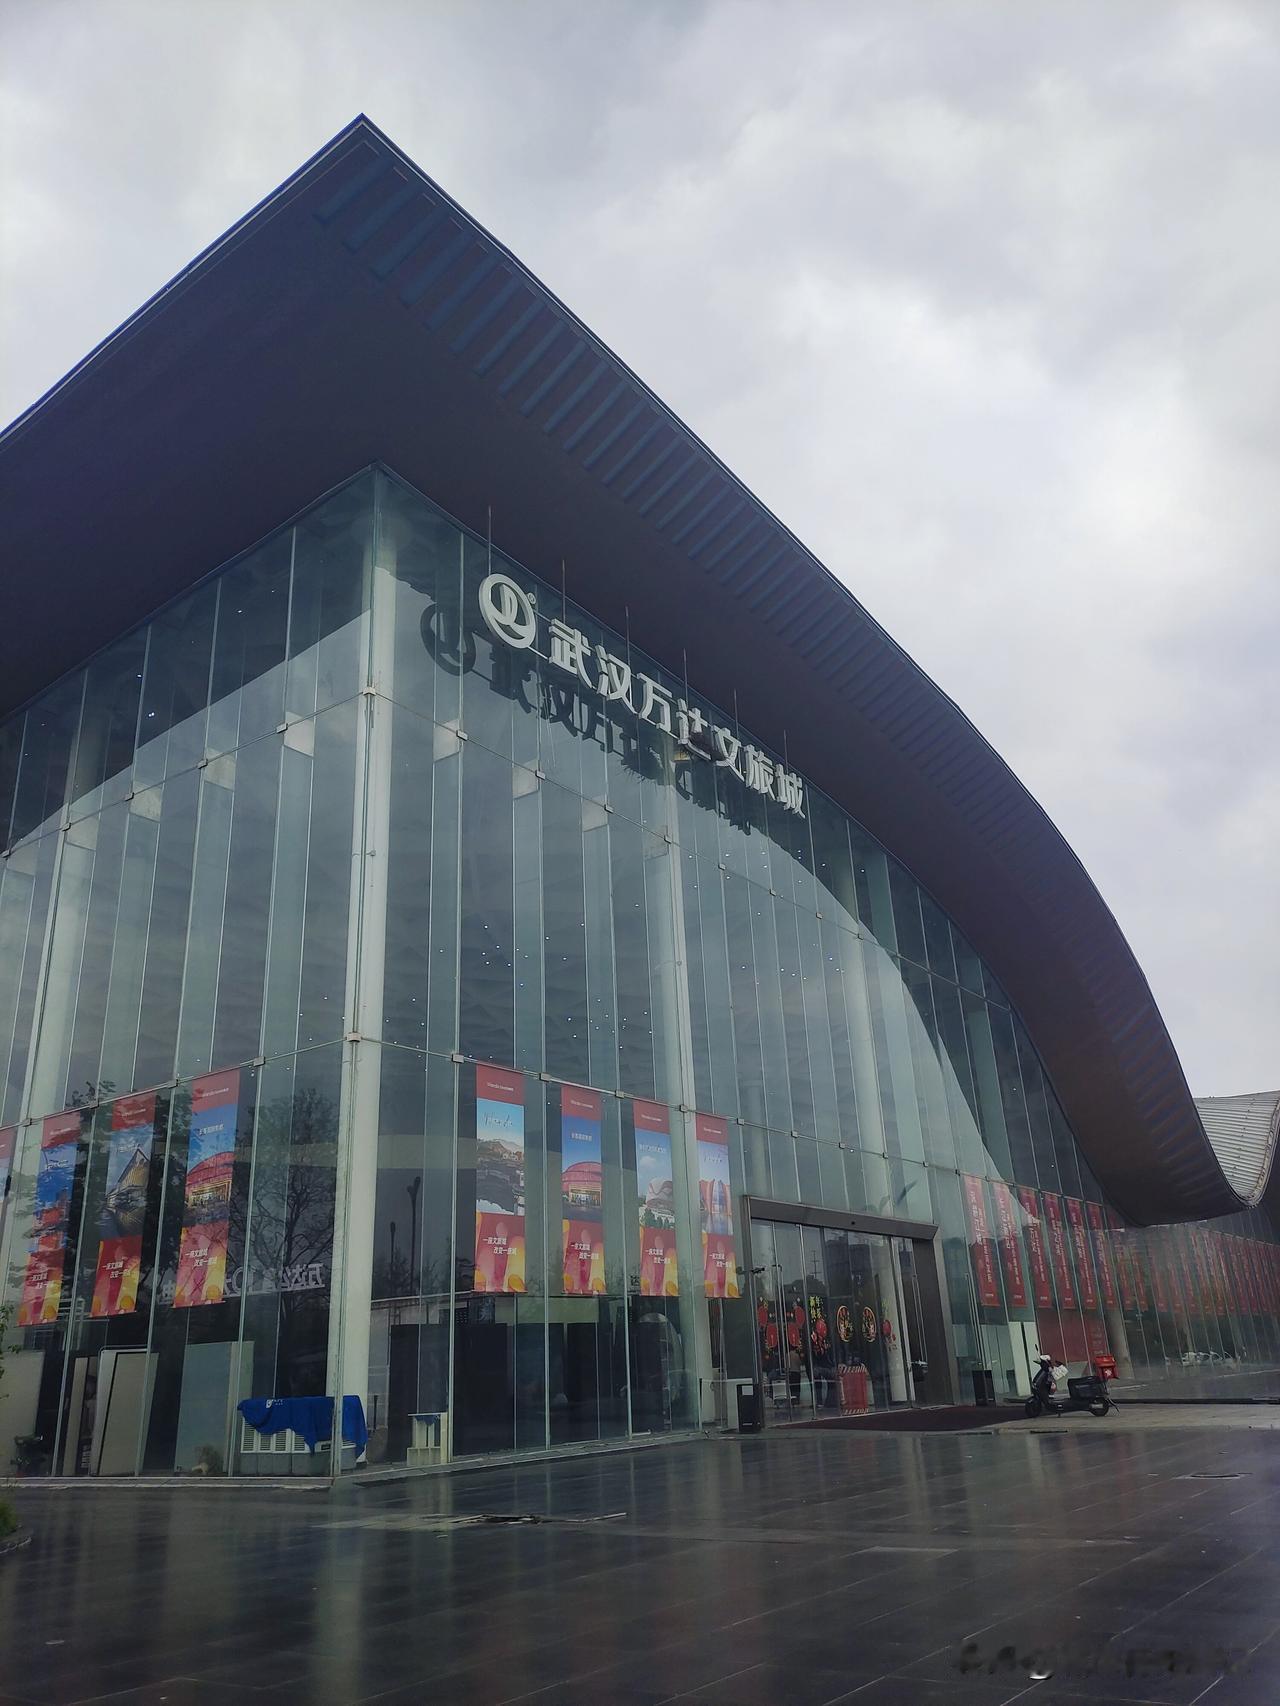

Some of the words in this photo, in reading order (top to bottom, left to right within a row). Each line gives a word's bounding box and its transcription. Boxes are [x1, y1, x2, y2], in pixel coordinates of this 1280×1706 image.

[548, 617, 806, 819] 武汉万达文旅城
